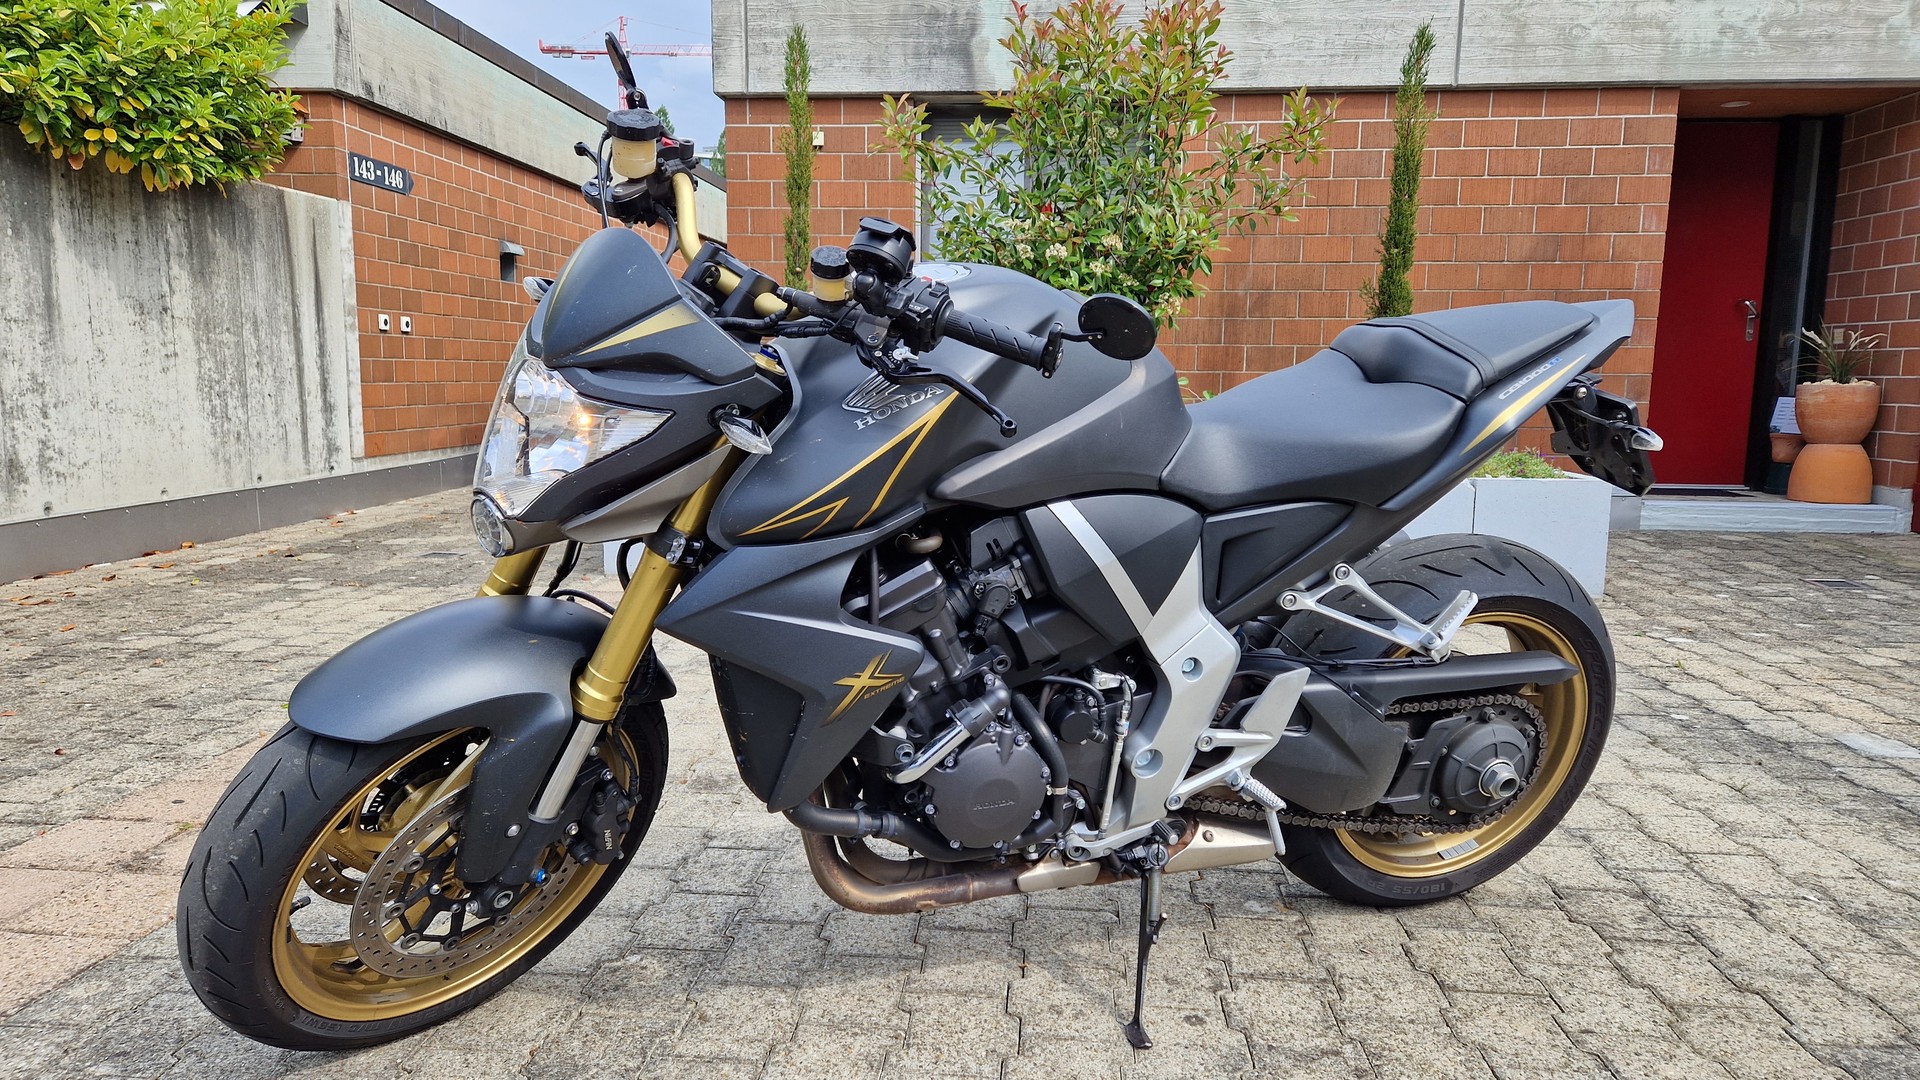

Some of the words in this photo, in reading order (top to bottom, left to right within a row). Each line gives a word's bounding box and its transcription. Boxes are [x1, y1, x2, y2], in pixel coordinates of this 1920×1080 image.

[853, 385, 945, 431] HONDA
[863, 676, 905, 700] EXTREME
[1392, 883, 1446, 895] 180/55
